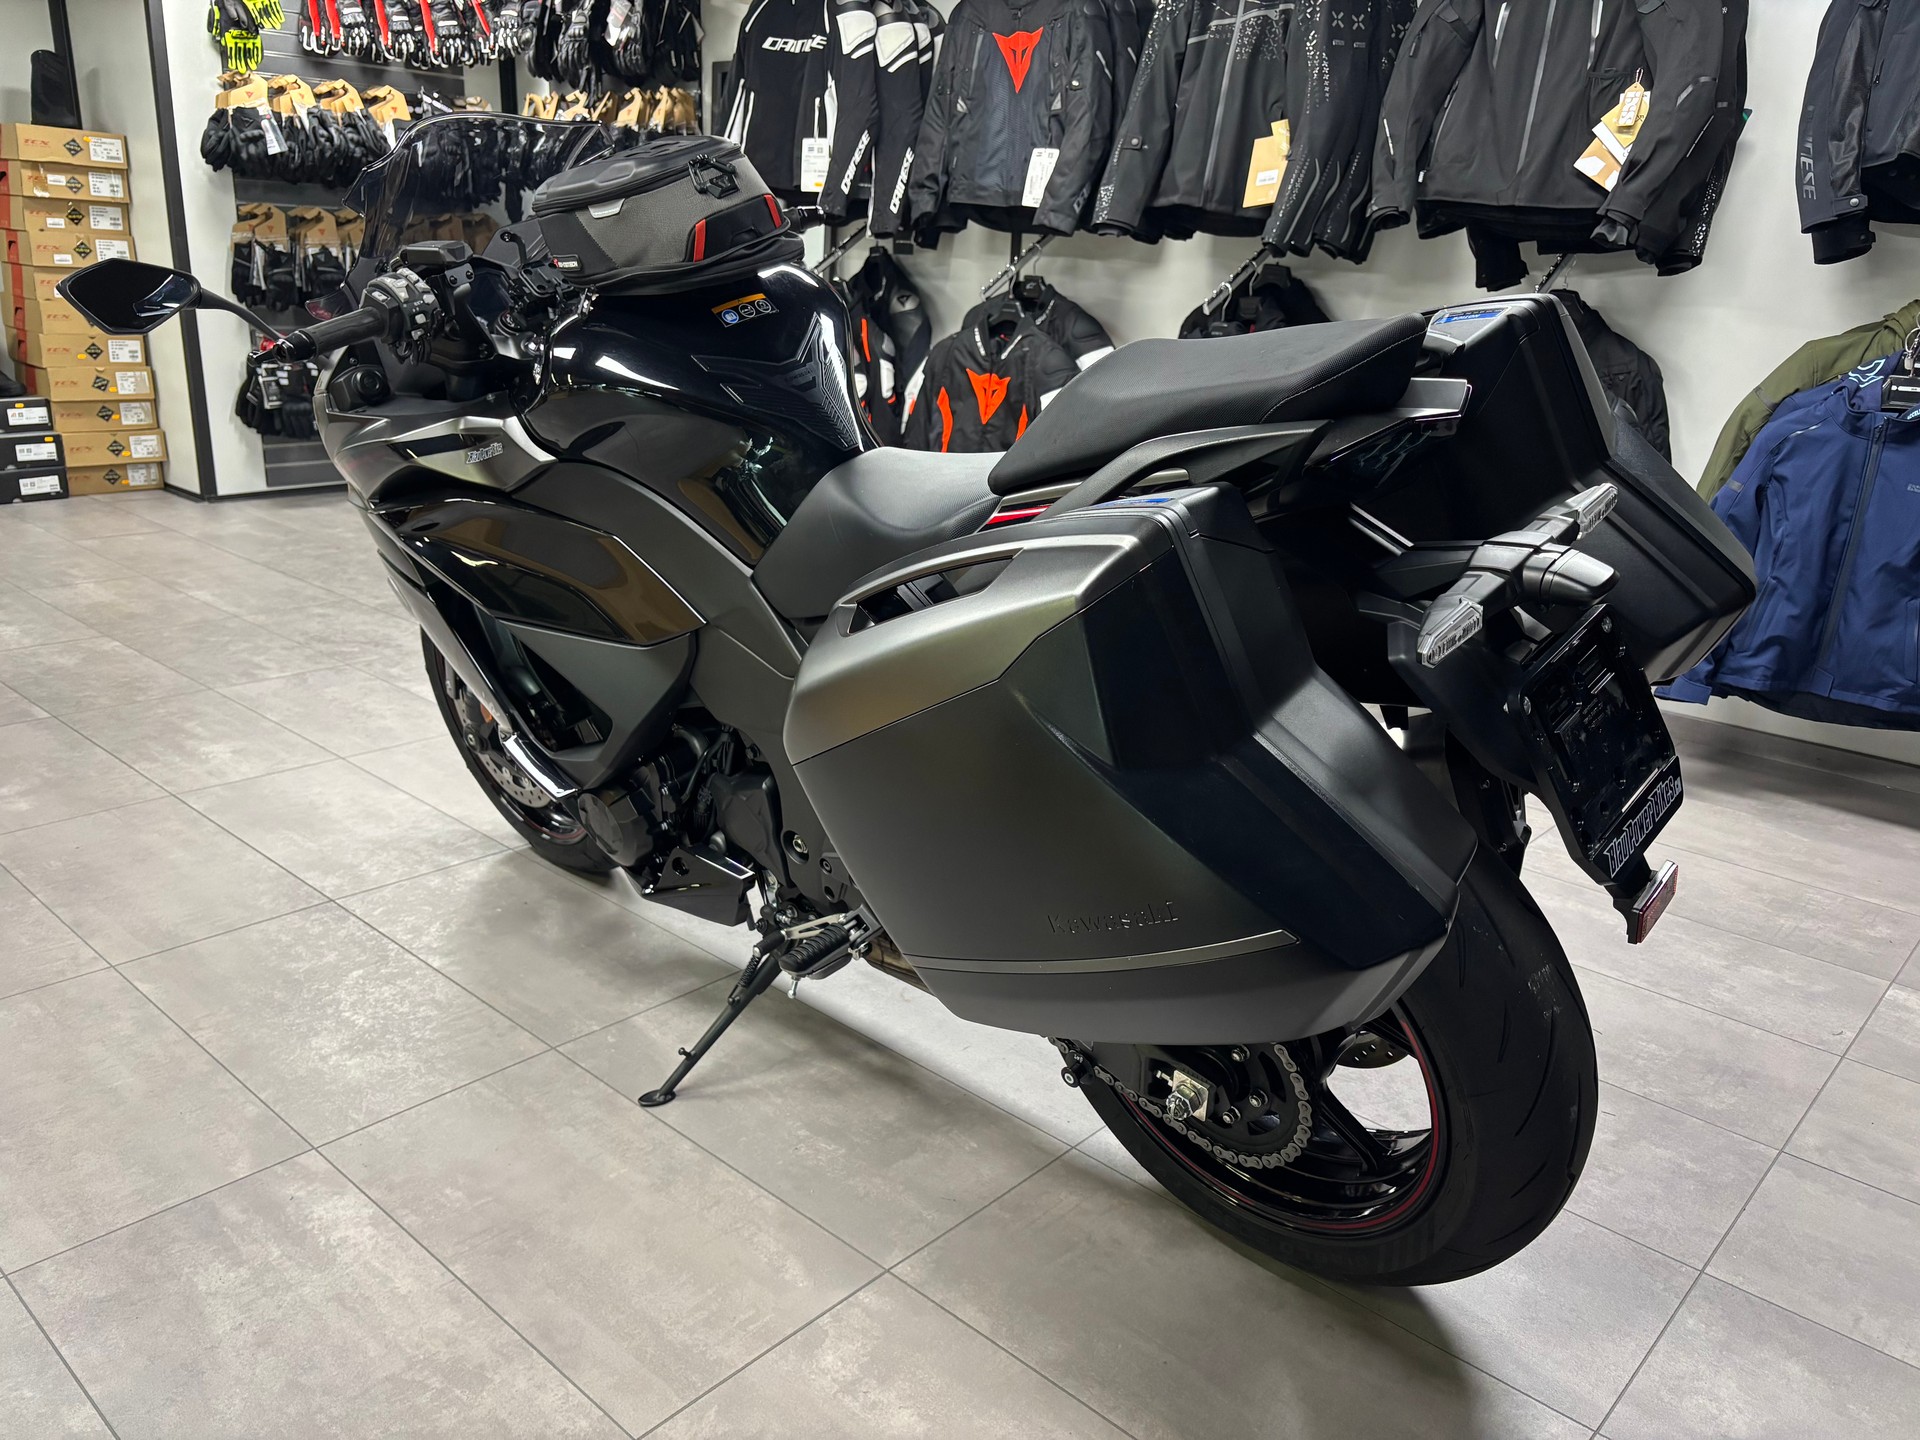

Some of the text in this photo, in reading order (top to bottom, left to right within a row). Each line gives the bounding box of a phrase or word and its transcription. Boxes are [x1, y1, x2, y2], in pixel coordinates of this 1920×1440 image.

[840, 129, 871, 195] DAINESE
[889, 146, 916, 214] DAINESE
[1047, 900, 1179, 934] Kawasaki
